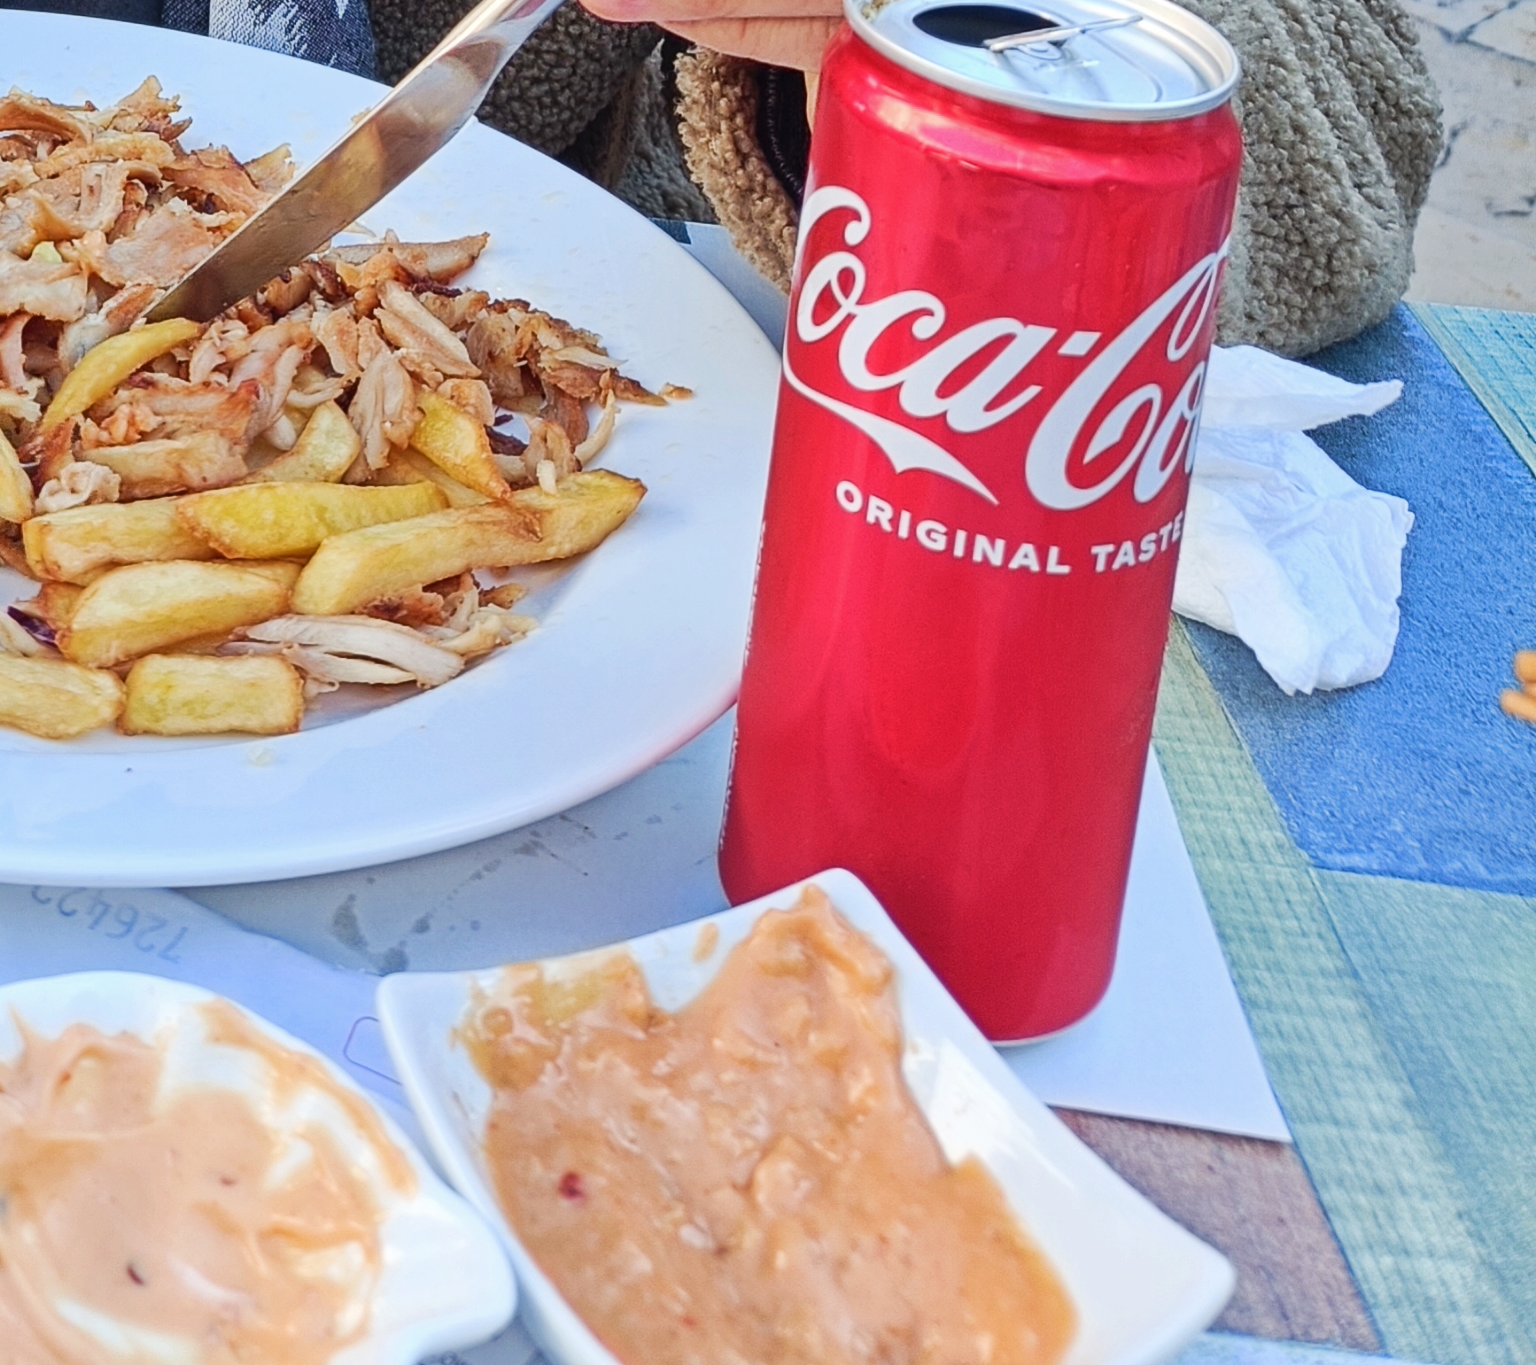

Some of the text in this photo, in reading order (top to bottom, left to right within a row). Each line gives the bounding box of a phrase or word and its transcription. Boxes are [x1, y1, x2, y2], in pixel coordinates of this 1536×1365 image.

[783, 184, 1231, 512] Coca-Co
[835, 479, 1184, 575] ORIGINAL TASTE
